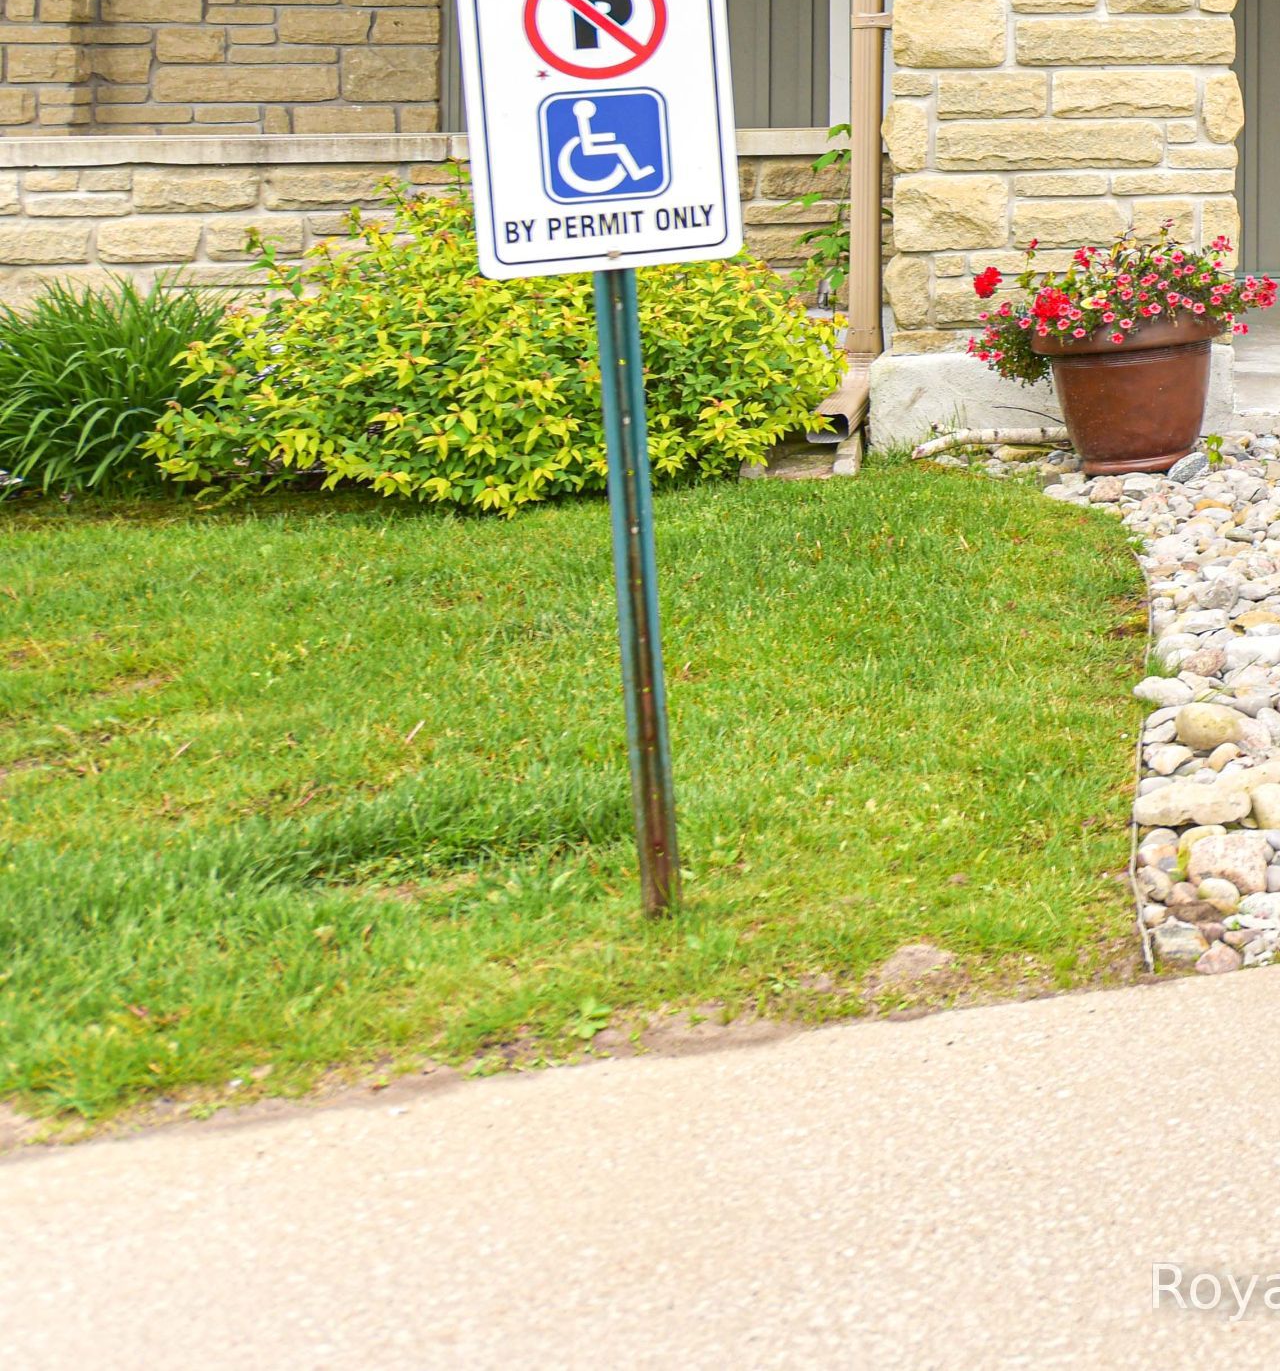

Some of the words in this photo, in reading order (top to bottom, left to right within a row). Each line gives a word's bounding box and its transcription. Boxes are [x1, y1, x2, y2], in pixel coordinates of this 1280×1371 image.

[506, 219, 535, 244] BY
[547, 210, 644, 241] PERMIT
[656, 204, 714, 231] ONLY
